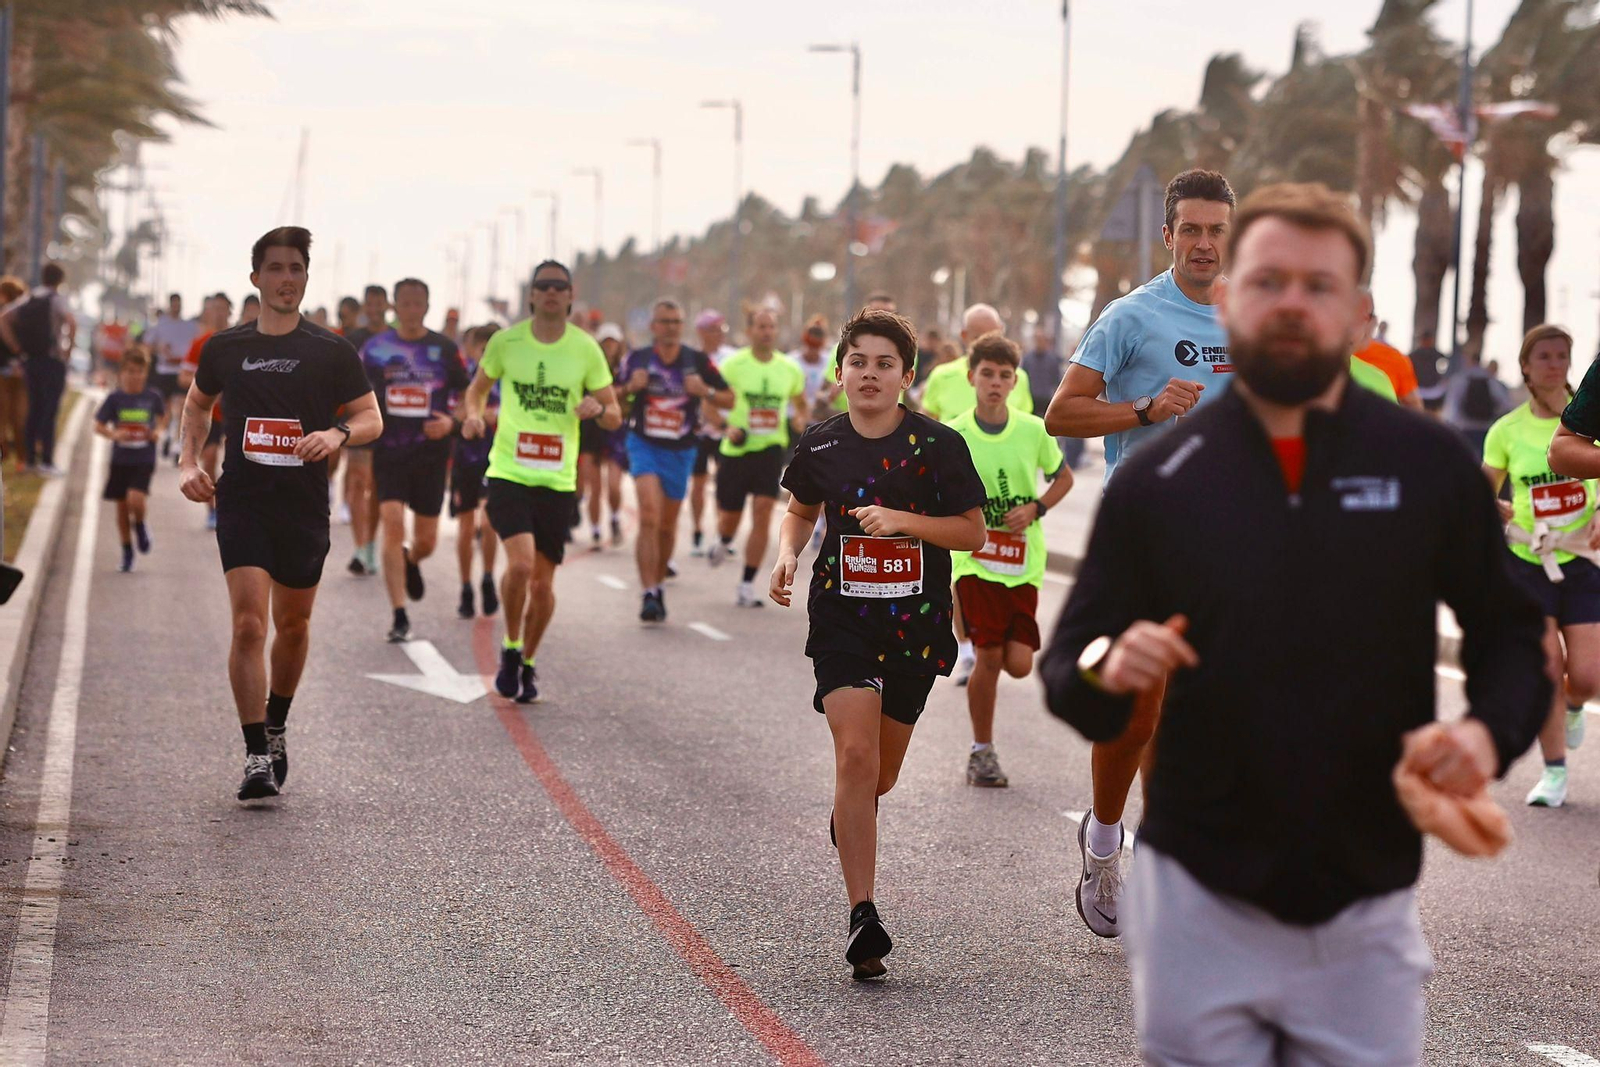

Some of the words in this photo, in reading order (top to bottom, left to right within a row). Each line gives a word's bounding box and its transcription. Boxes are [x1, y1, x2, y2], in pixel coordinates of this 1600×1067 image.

[258, 358, 301, 373] NIKE
[985, 511, 1006, 528] RU
[1000, 546, 1020, 557] 981
[845, 555, 877, 565] BRUNCH
[883, 559, 912, 573] 581
[848, 562, 864, 573] RUN
